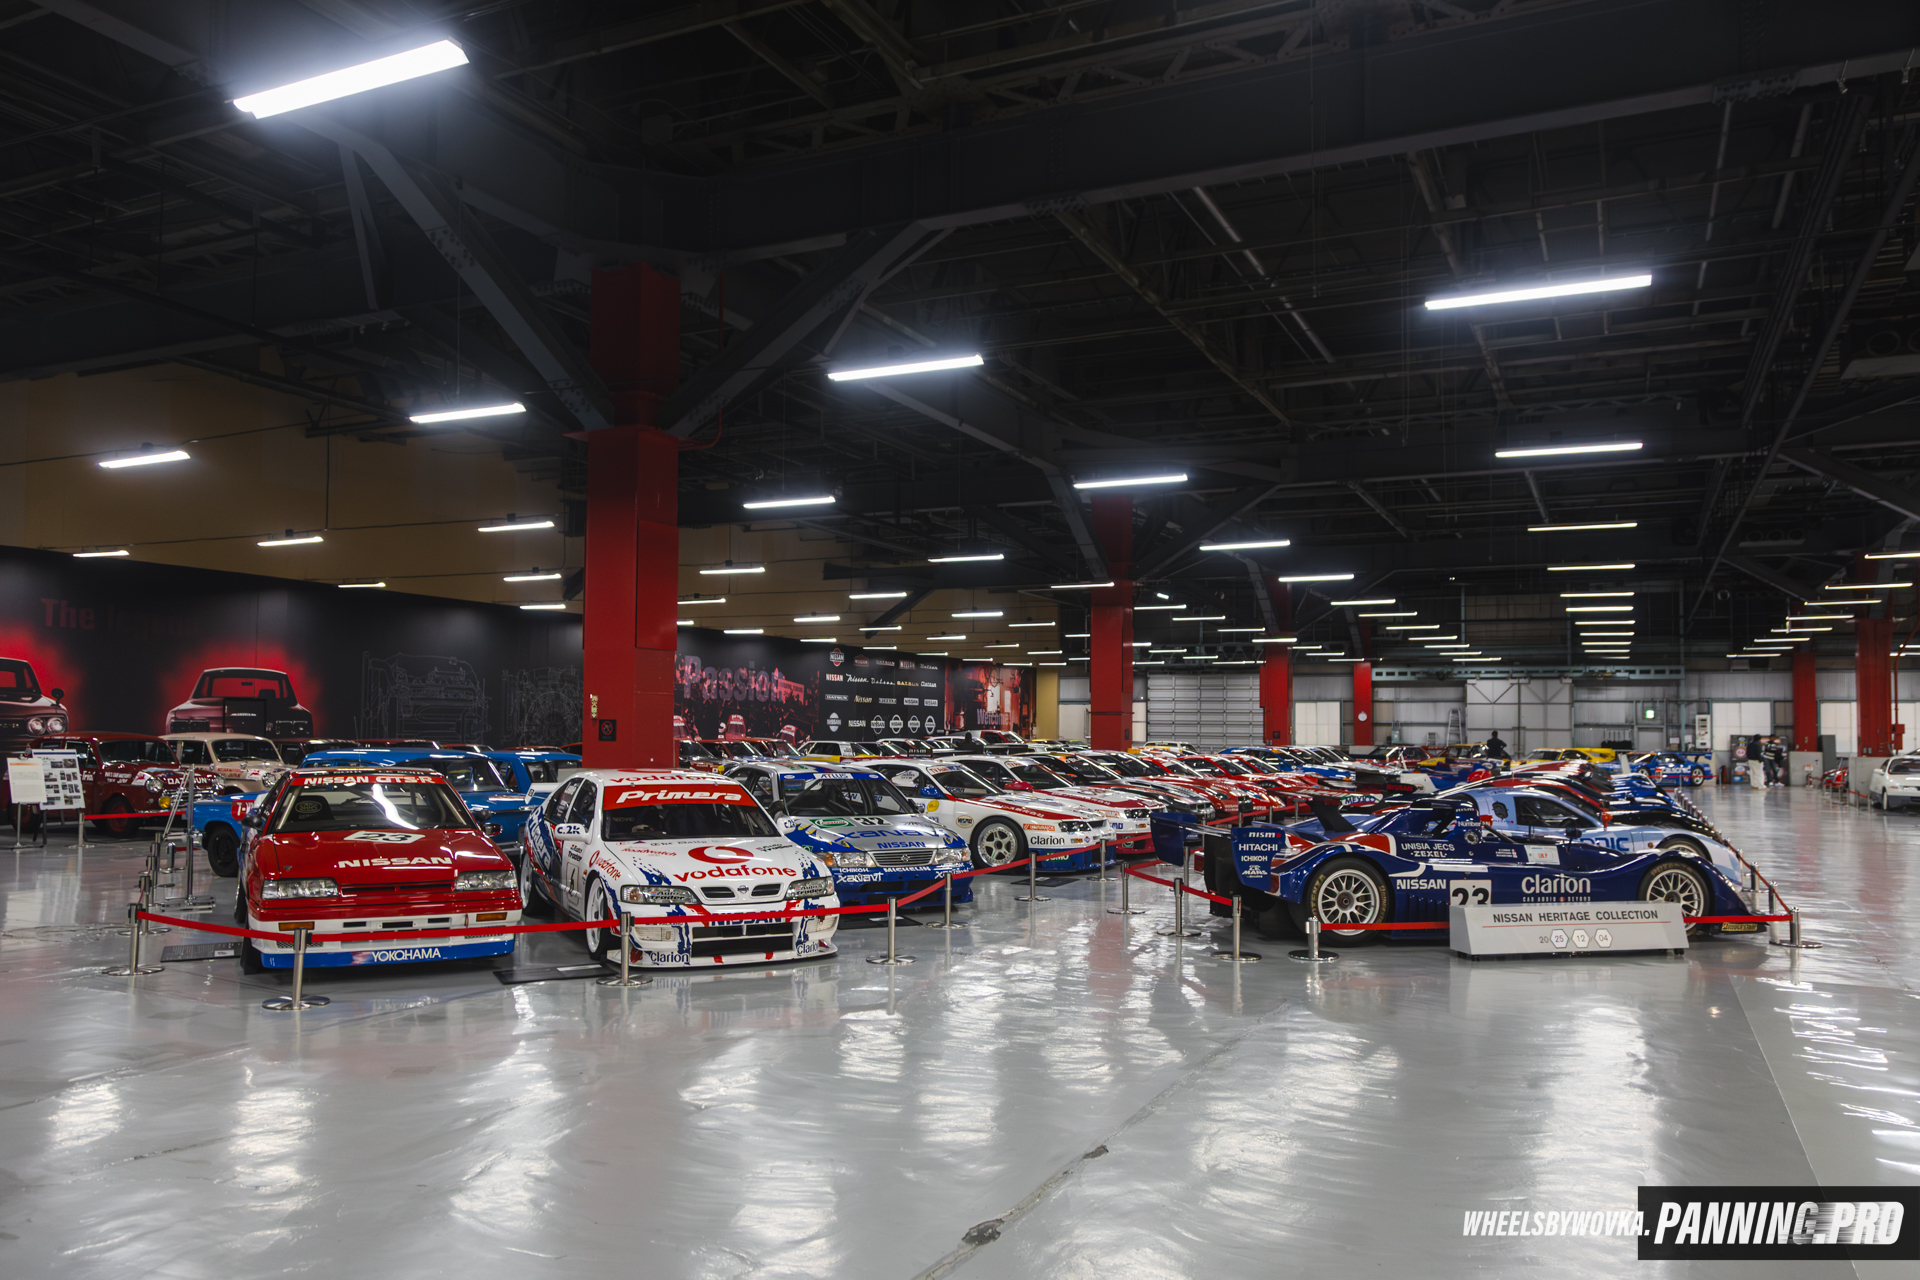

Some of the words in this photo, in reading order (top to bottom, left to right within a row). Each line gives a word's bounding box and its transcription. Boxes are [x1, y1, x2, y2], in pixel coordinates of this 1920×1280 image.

[41, 598, 95, 630] The
[830, 652, 844, 661] NISSAN
[683, 655, 785, 702] Passion
[826, 673, 843, 681] NISSAN
[854, 695, 872, 703] Nissan
[303, 775, 369, 785] NISSAN
[1386, 784, 1414, 792] NISSAN
[616, 790, 742, 804] Primera
[1344, 796, 1376, 804] MEXICO
[853, 818, 888, 826] 32
[359, 831, 413, 841] 23
[876, 841, 926, 849] NISSAN
[1432, 843, 1455, 851] JECS
[338, 857, 453, 868] NISSAN
[595, 856, 621, 882] vodafone
[672, 864, 797, 883] vodafone
[1396, 879, 1447, 889] NISSAN
[1451, 887, 1490, 905] 23
[1492, 913, 1533, 923] NISSAN
[1538, 911, 1591, 921] HERITAGE
[1595, 910, 1659, 921] COLLECTION
[1539, 936, 1549, 944] 20
[1554, 935, 1564, 943] 25
[1576, 935, 1586, 943] 12
[1598, 934, 1609, 942] 04
[371, 948, 442, 963] YOKOHAMA
